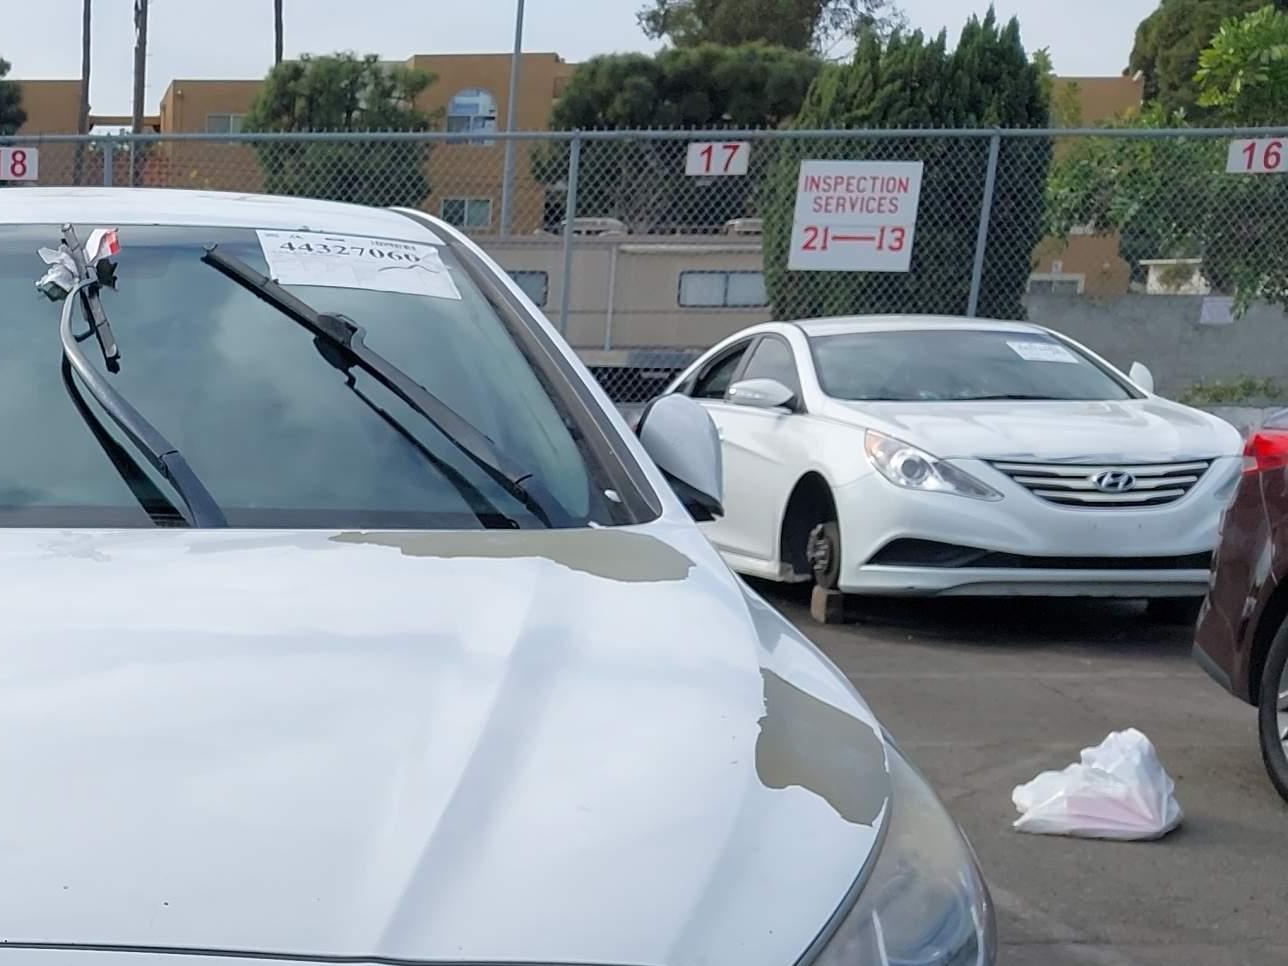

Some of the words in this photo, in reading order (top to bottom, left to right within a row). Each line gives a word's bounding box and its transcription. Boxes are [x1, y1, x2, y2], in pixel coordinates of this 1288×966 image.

[700, 144, 740, 173] 17
[1242, 141, 1283, 170] 16
[804, 175, 909, 194] INSPECTION
[812, 196, 899, 214] SERVICES
